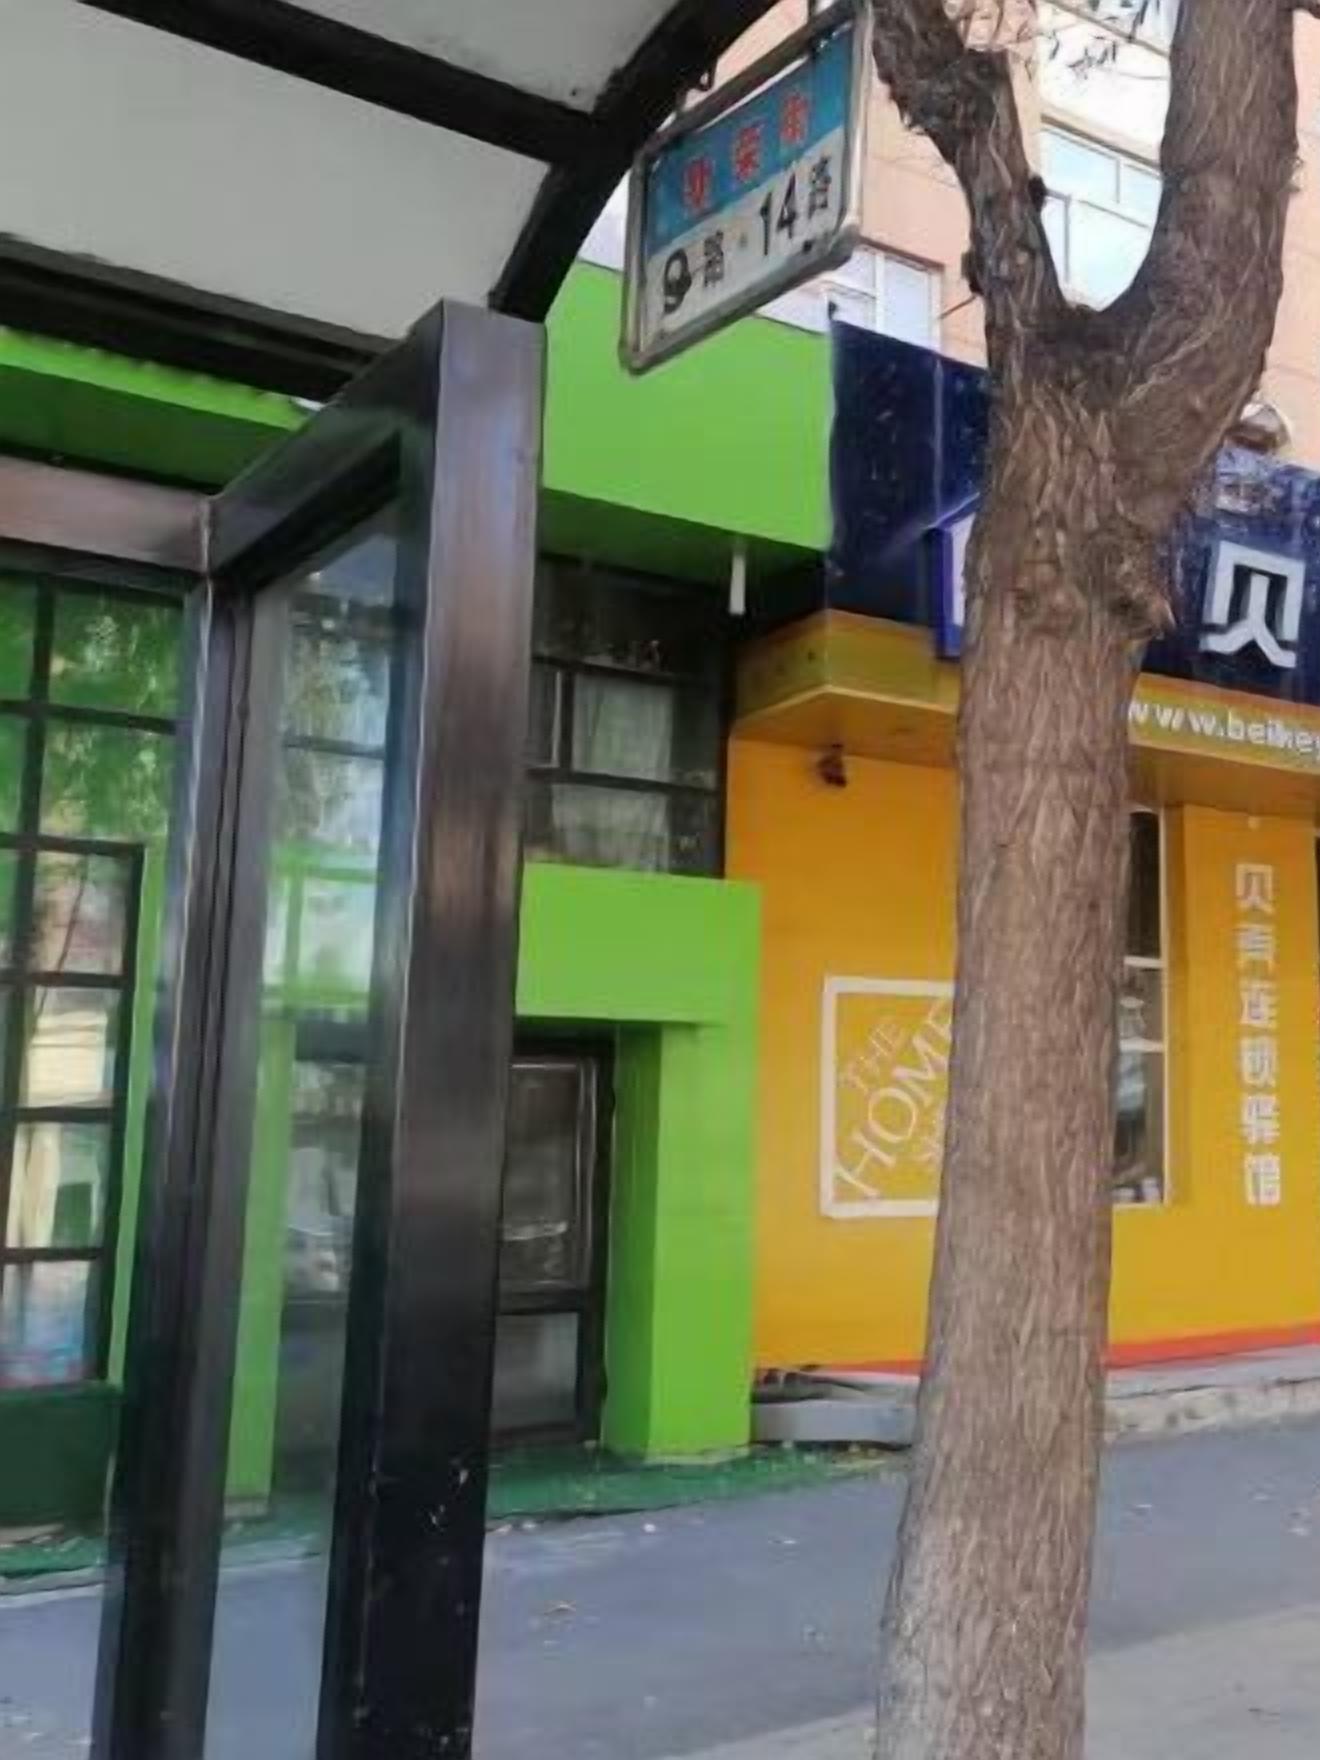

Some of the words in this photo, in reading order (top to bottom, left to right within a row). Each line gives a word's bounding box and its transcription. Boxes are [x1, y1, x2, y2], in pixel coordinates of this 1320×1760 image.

[1235, 863, 1281, 1207] 贝壳连锁驿馆
